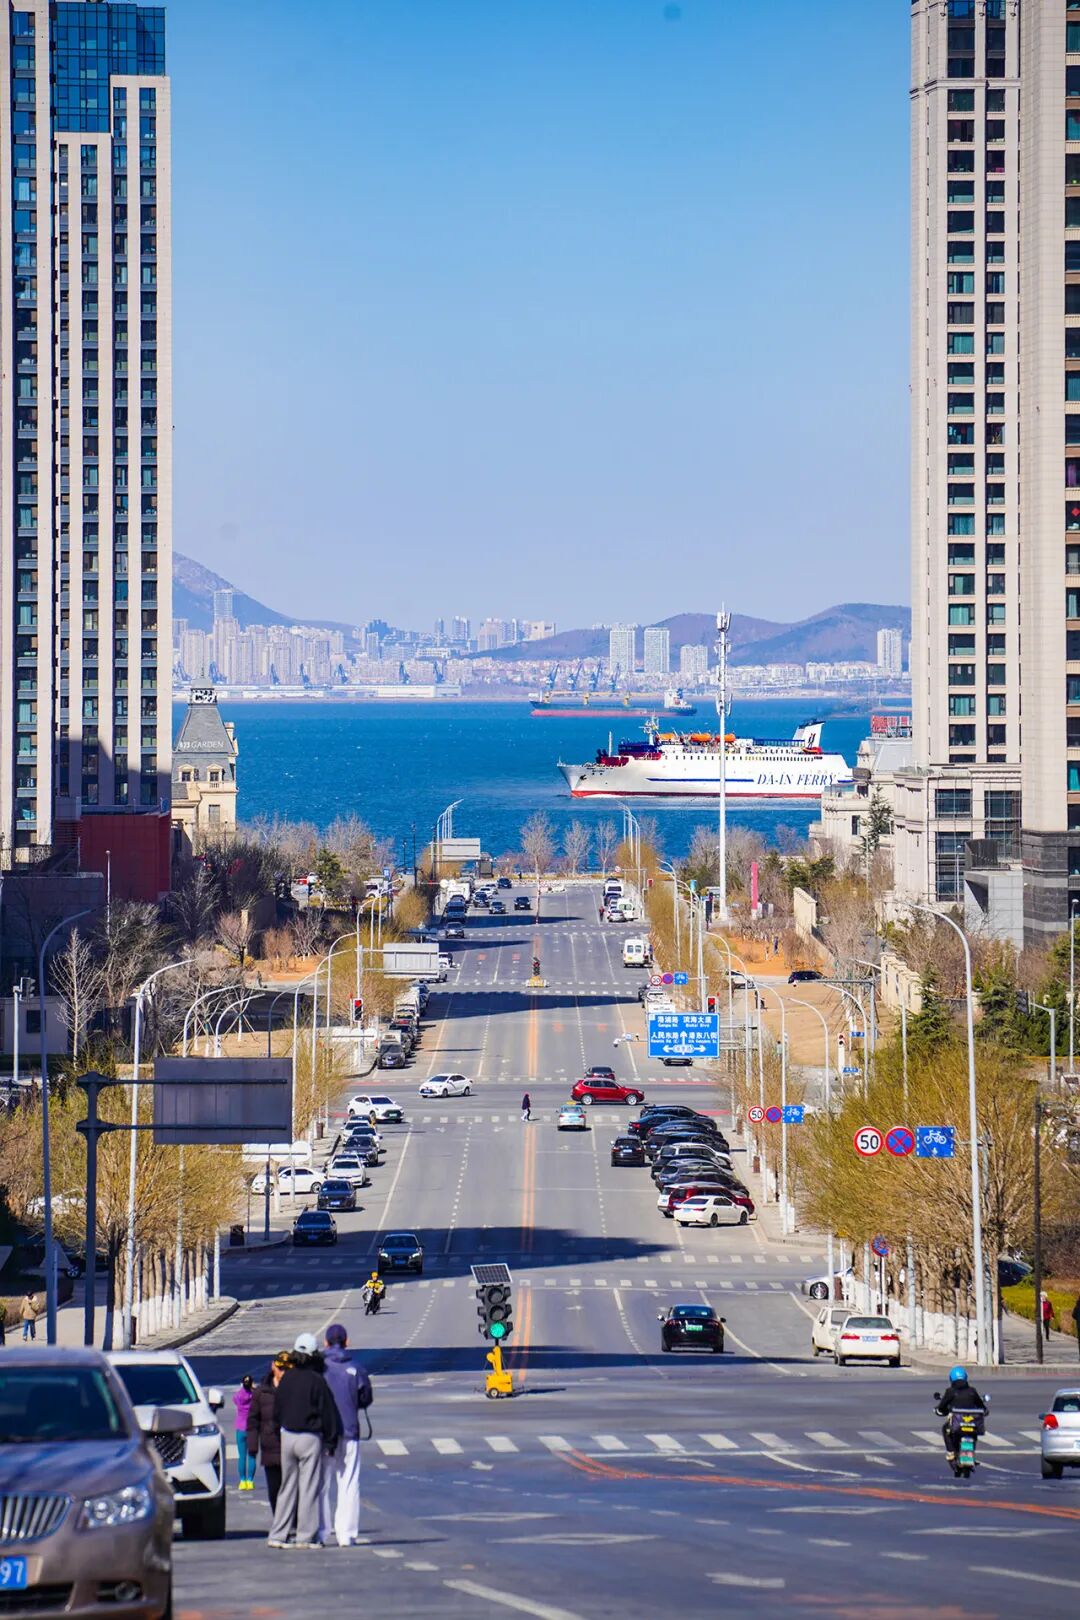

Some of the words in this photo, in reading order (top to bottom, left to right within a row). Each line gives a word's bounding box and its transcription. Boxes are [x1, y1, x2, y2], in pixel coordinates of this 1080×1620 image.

[757, 774, 793, 785] DA-IN
[797, 774, 836, 785] FERRY
[751, 1110, 763, 1119] 50
[860, 1134, 879, 1150] 50
[0, 1560, 24, 1584] 97
